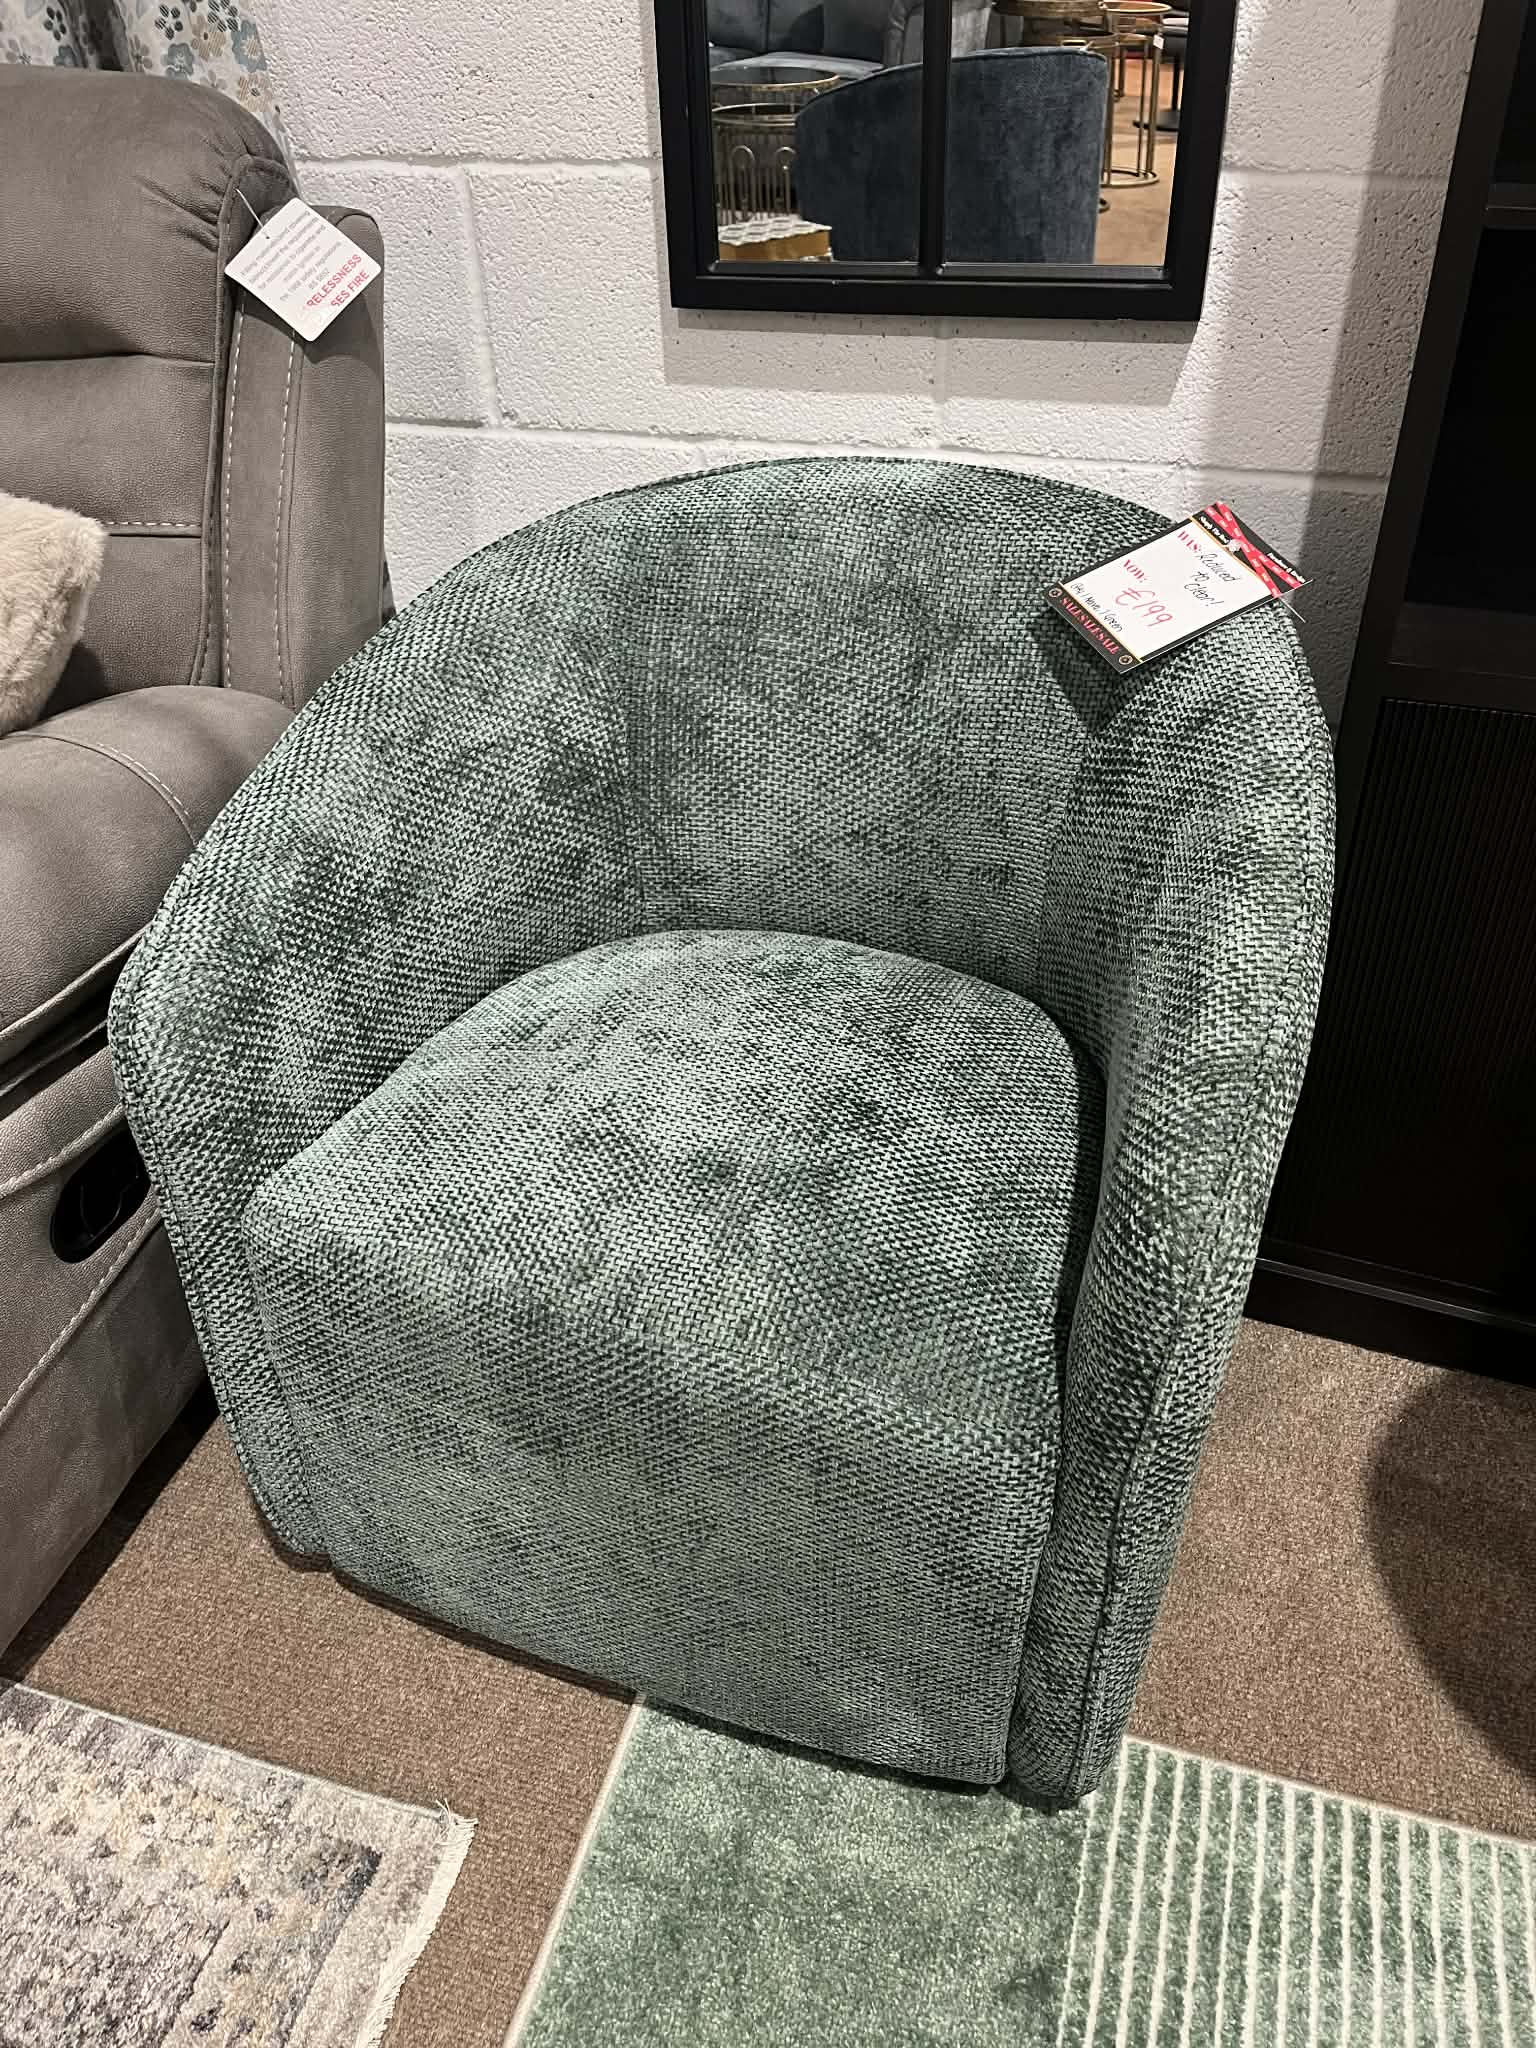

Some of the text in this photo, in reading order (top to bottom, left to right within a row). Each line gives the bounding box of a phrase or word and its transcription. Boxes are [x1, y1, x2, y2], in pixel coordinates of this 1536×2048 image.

[306, 253, 362, 308] RELESSNESS
[349, 270, 370, 293] FIRE
[1115, 587, 1173, 627] €199
